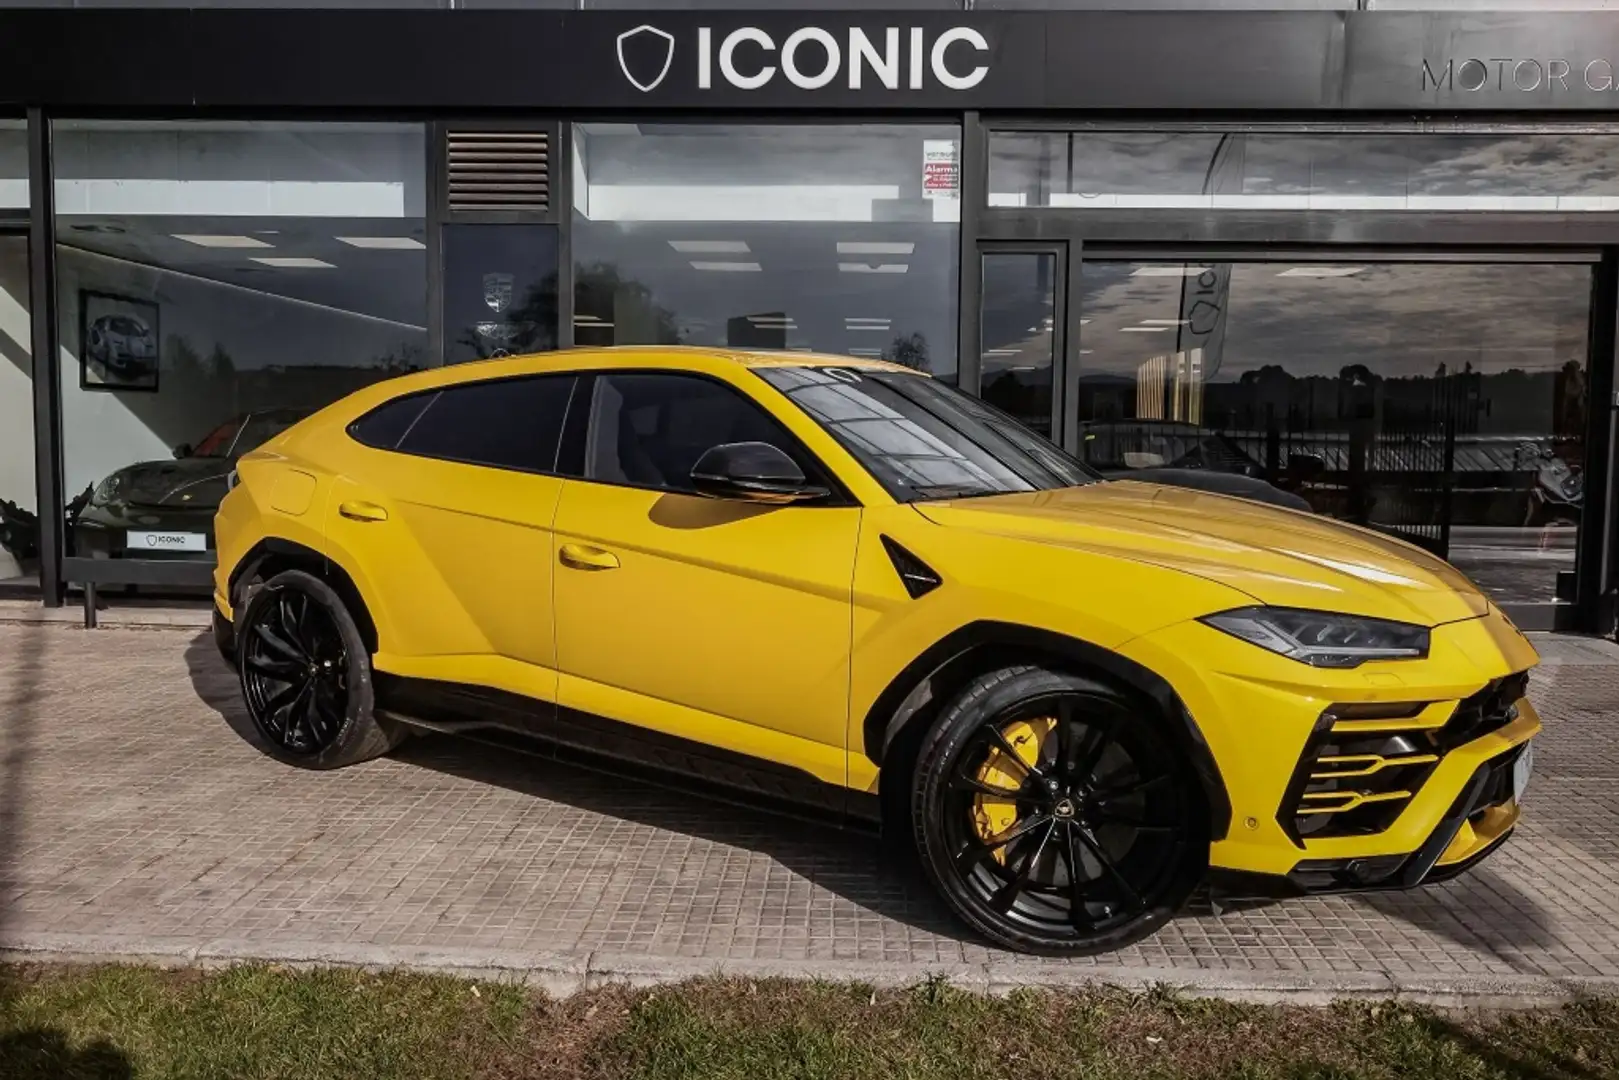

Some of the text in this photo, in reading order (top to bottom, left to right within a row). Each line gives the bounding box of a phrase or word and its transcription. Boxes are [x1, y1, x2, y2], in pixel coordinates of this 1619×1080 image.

[698, 26, 990, 90] ICONIC
[1422, 58, 1619, 92] MOTOR G
